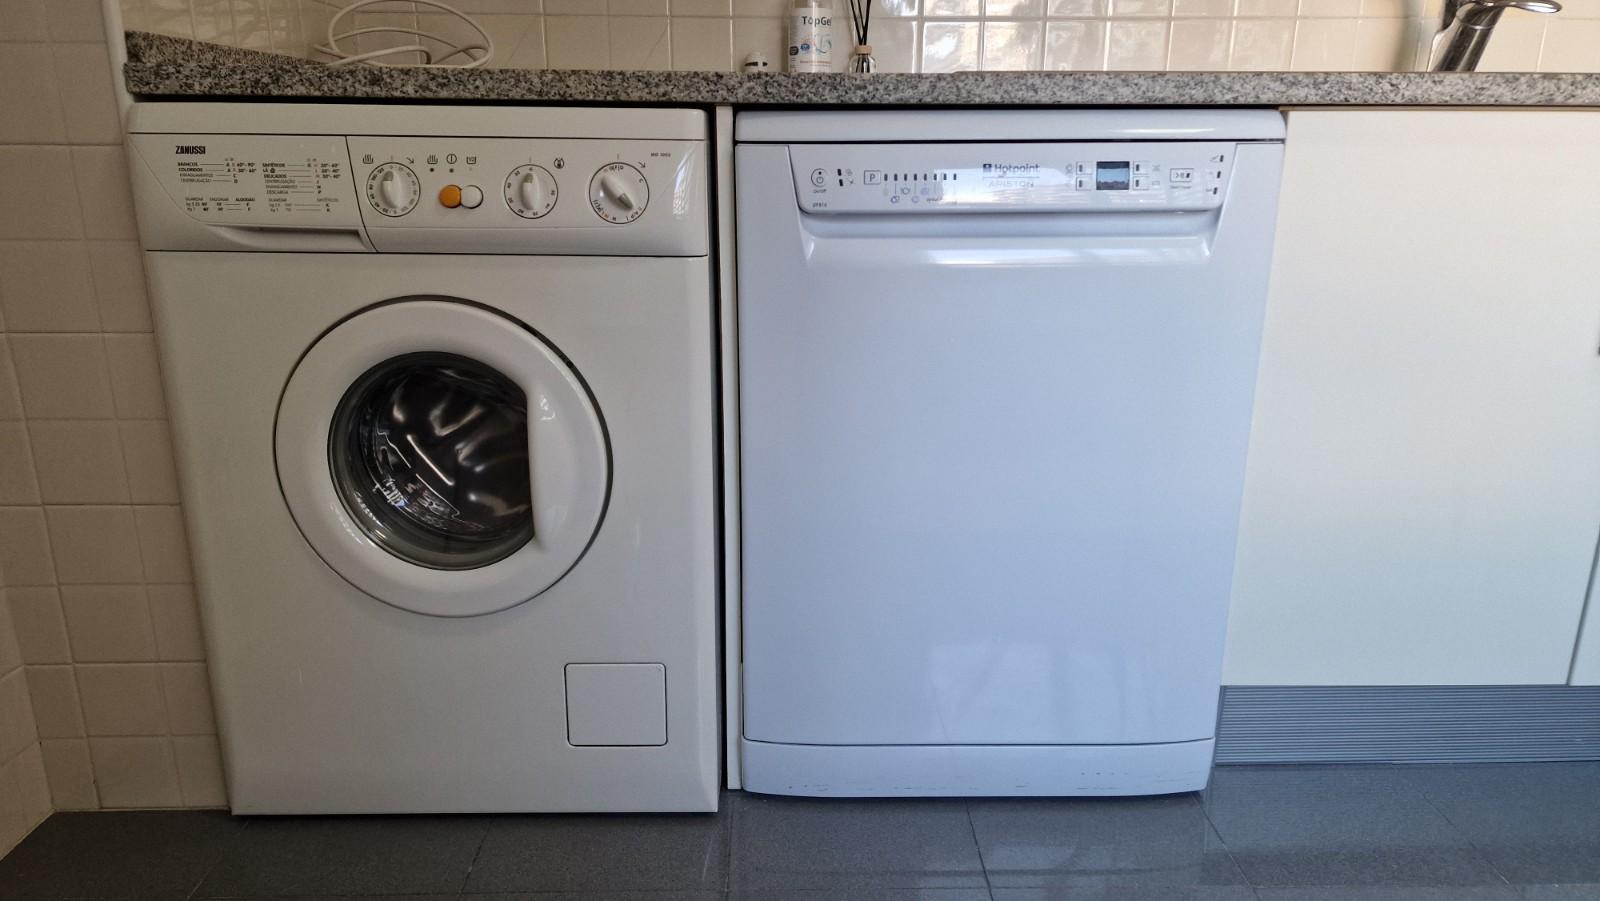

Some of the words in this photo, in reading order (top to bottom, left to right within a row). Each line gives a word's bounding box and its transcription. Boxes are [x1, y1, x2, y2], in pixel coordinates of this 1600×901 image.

[175, 145, 206, 155] ZANUSSI
[994, 163, 1040, 174] Hotpoint
[869, 174, 876, 182] P
[988, 180, 1034, 188] ARISTON
